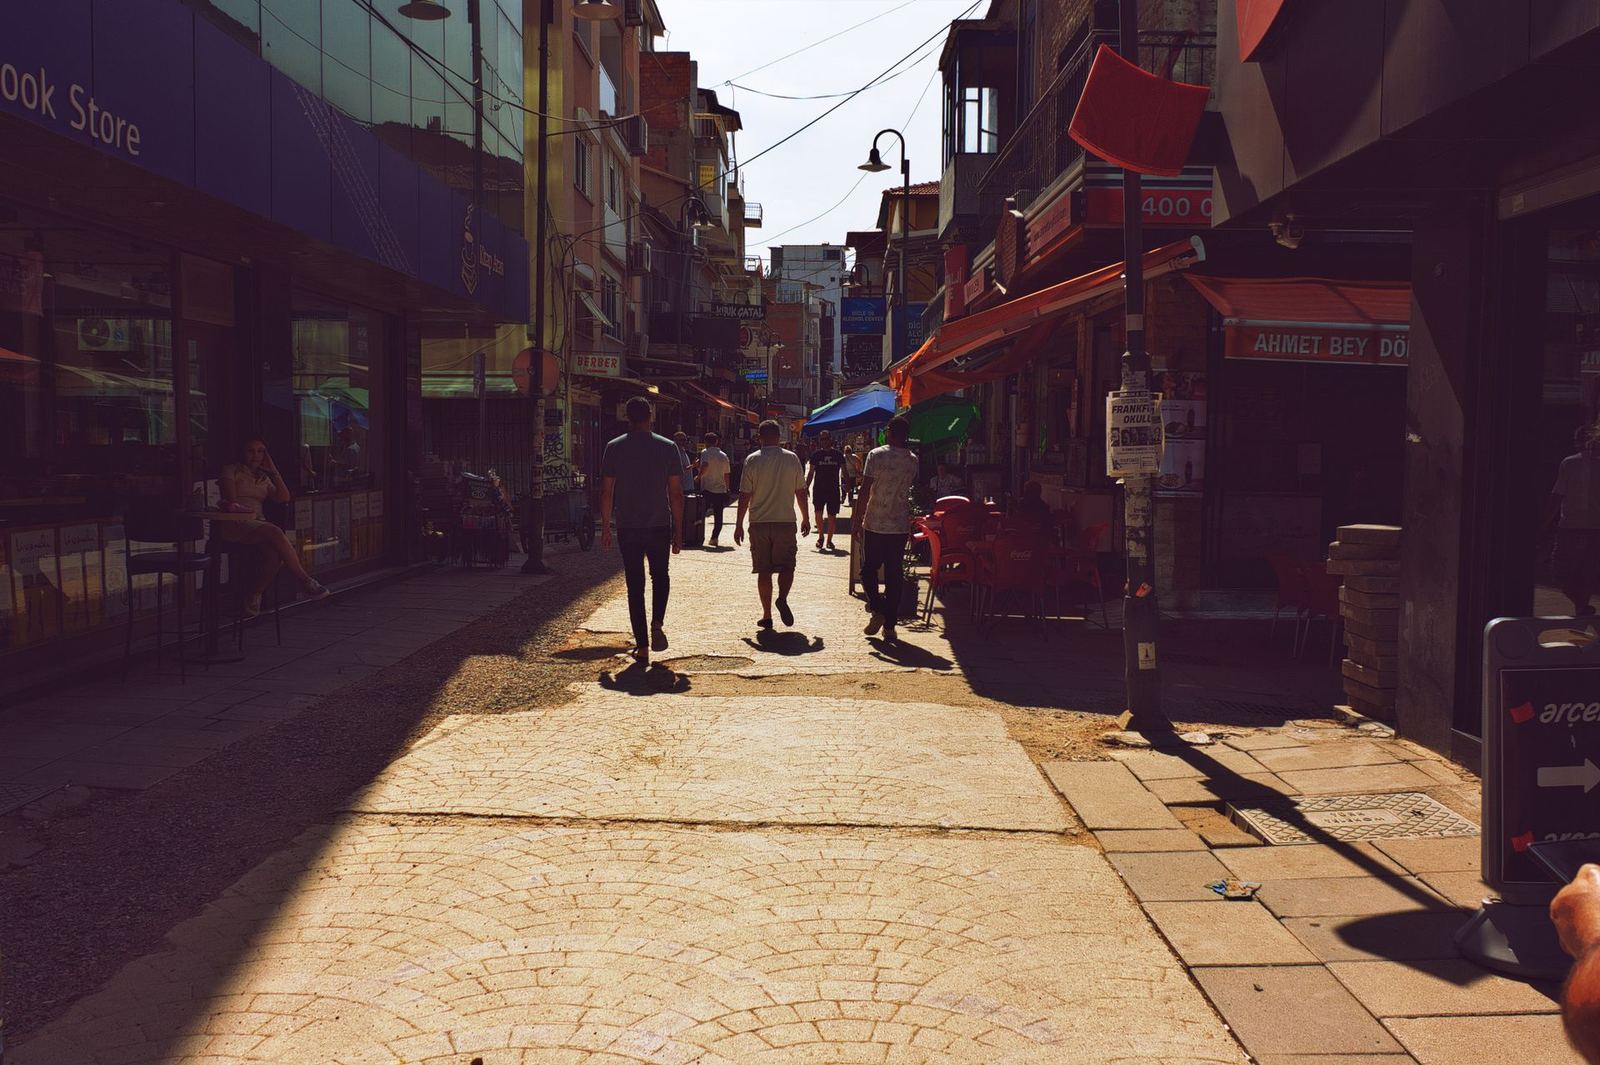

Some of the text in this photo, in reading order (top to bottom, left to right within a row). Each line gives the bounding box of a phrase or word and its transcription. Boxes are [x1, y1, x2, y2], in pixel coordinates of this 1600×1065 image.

[1, 63, 140, 155] ook Store
[1141, 197, 1190, 216] 400
[1254, 333, 1409, 359] AHMET BEY DÖ
[577, 357, 617, 368] BERBER
